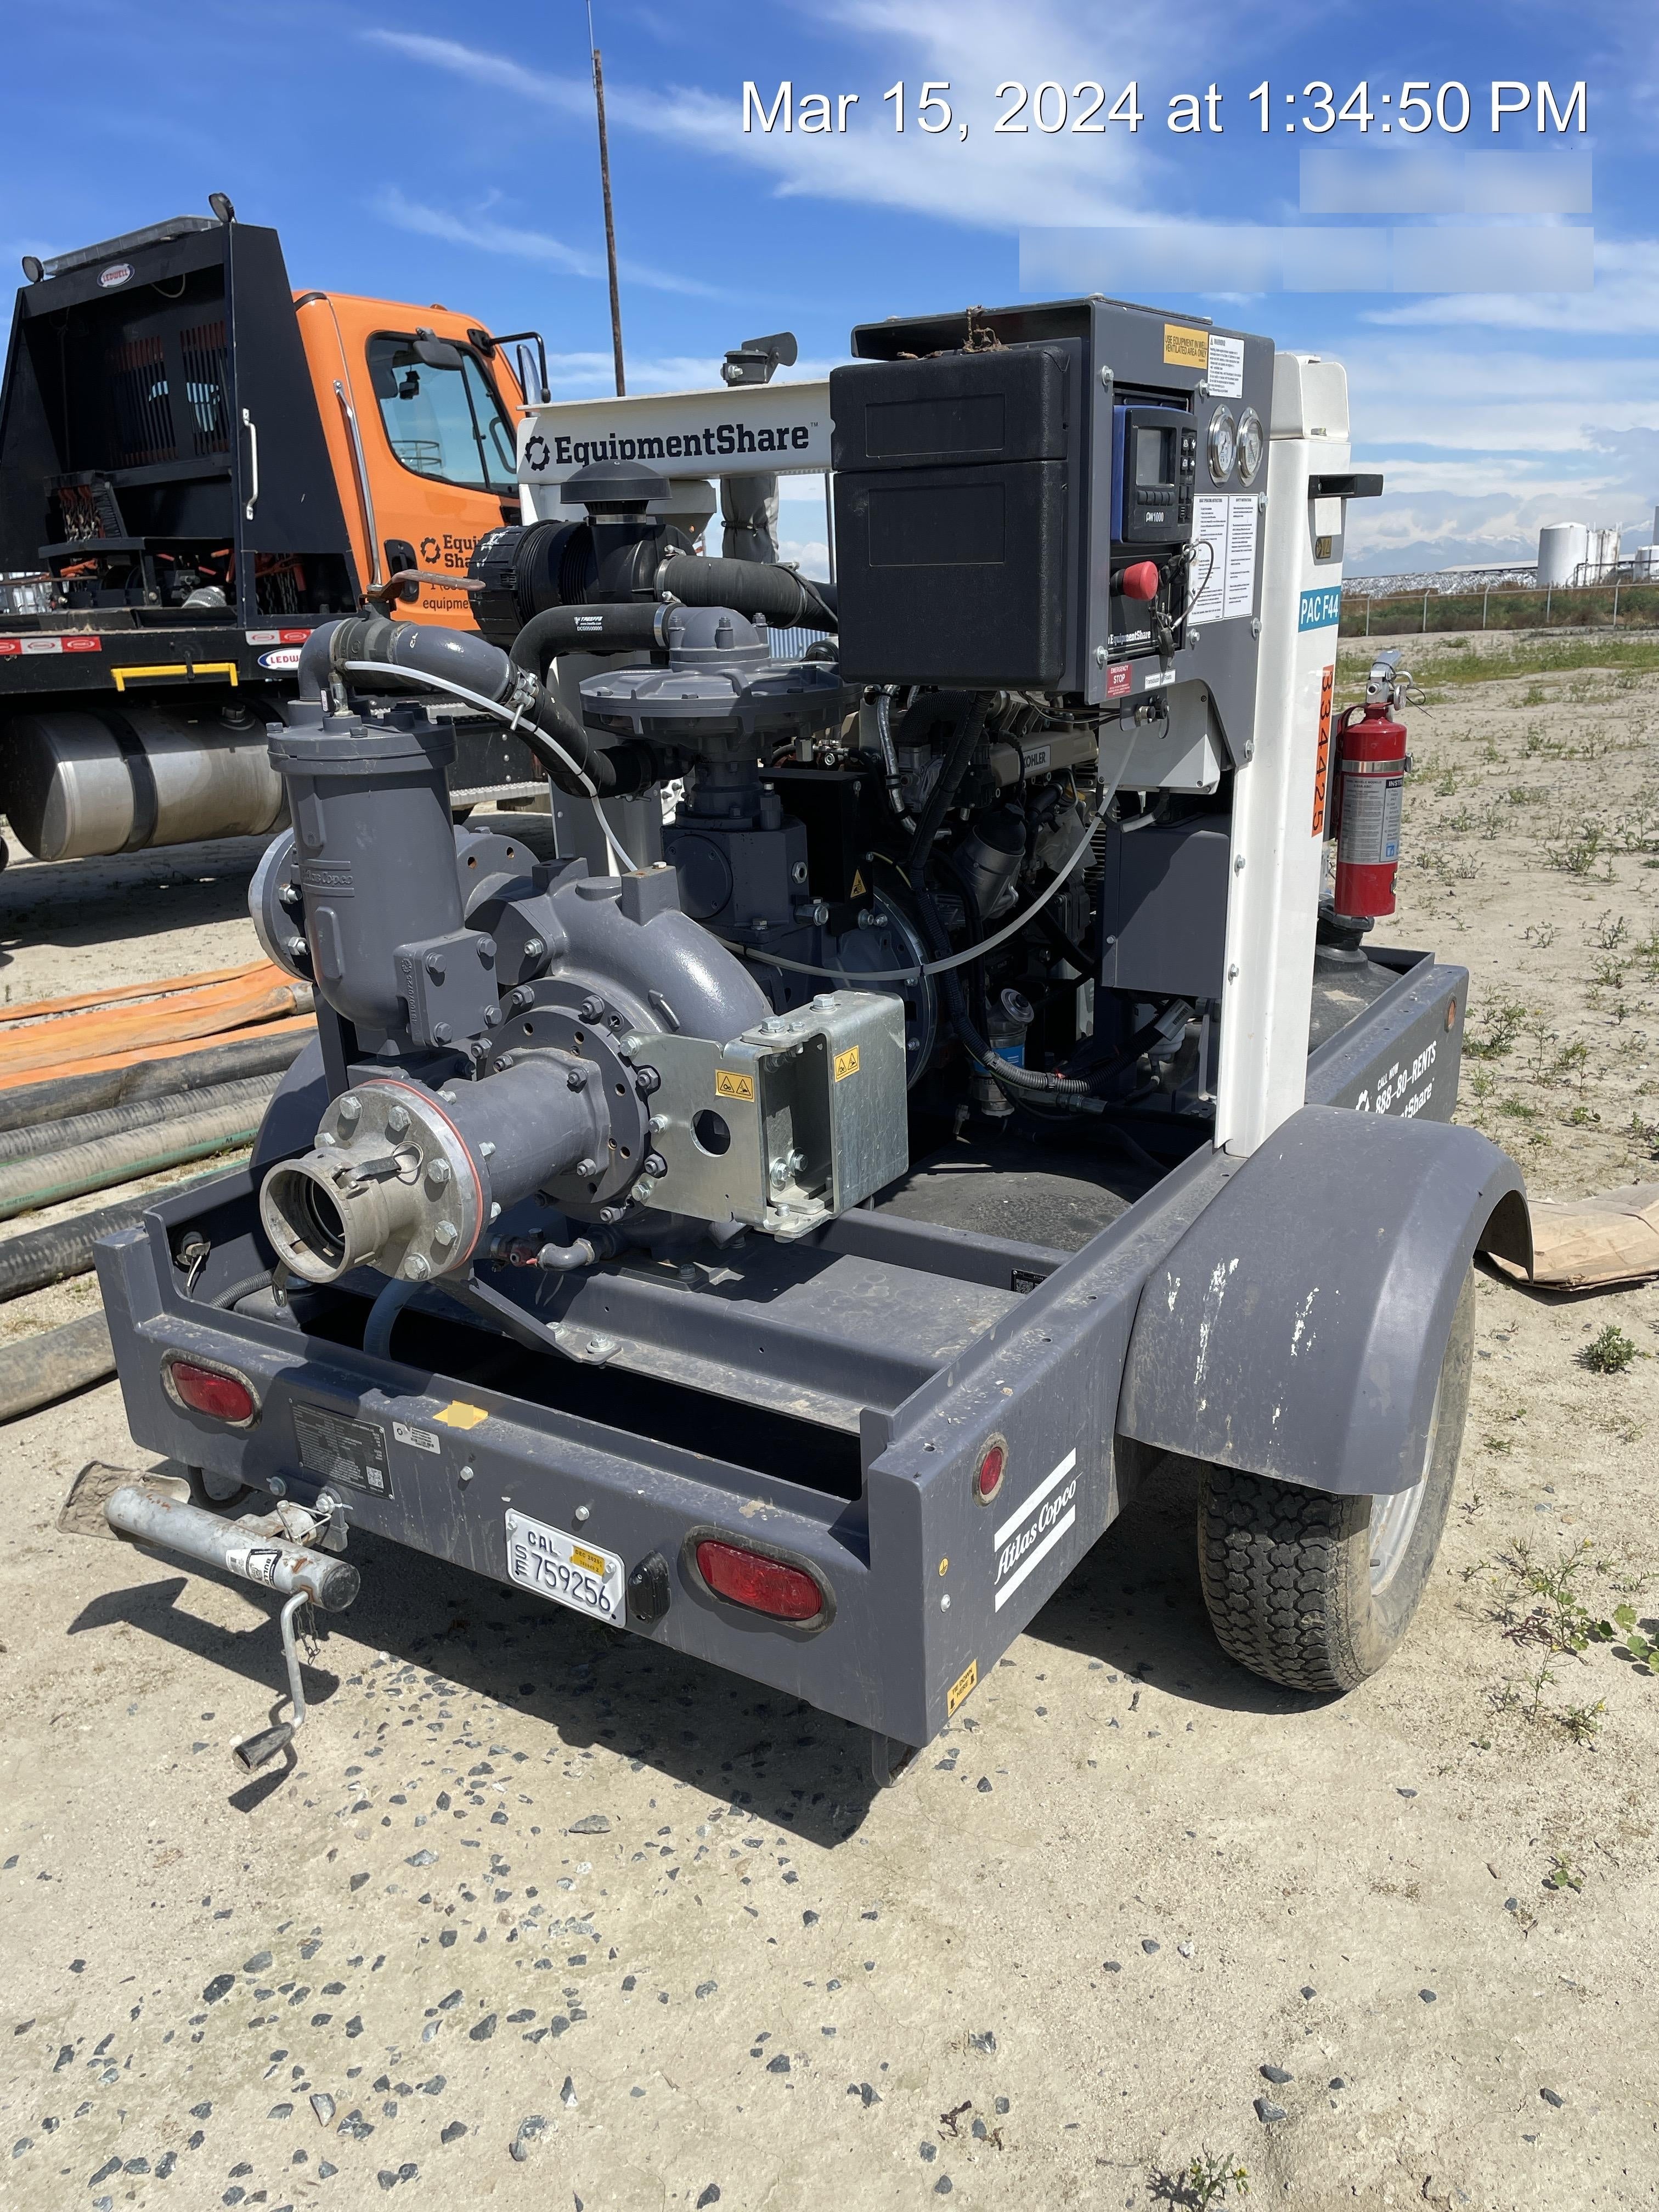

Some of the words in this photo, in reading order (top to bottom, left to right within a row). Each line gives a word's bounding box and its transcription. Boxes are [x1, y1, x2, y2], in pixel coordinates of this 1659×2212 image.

[1165, 343, 1187, 354] VENTILATED
[1187, 347, 1197, 356] AREA
[1198, 348, 1207, 358] ONLY
[1173, 336, 1194, 347] EQUIPMENT
[1198, 341, 1208, 350] WELL
[555, 423, 809, 469] EquipmentShare
[1300, 596, 1321, 625] PAC
[1322, 594, 1339, 620] F44
[1110, 630, 1151, 646] EquipmentShare
[1110, 664, 1129, 674] EMERGENCY
[1113, 673, 1126, 685] STOP
[1312, 671, 1333, 831] 334425
[1377, 1073, 1387, 1091] CALL
[1389, 1062, 1400, 1081] NOW
[994, 1522, 1037, 1585] Atlas
[1038, 1479, 1077, 1533] Copco
[527, 1531, 557, 1556] CAL
[575, 1549, 586, 1558] DEC
[531, 1552, 611, 1612] 759256
[959, 1668, 973, 1686] DOWN
[956, 1680, 969, 1698] HERE
